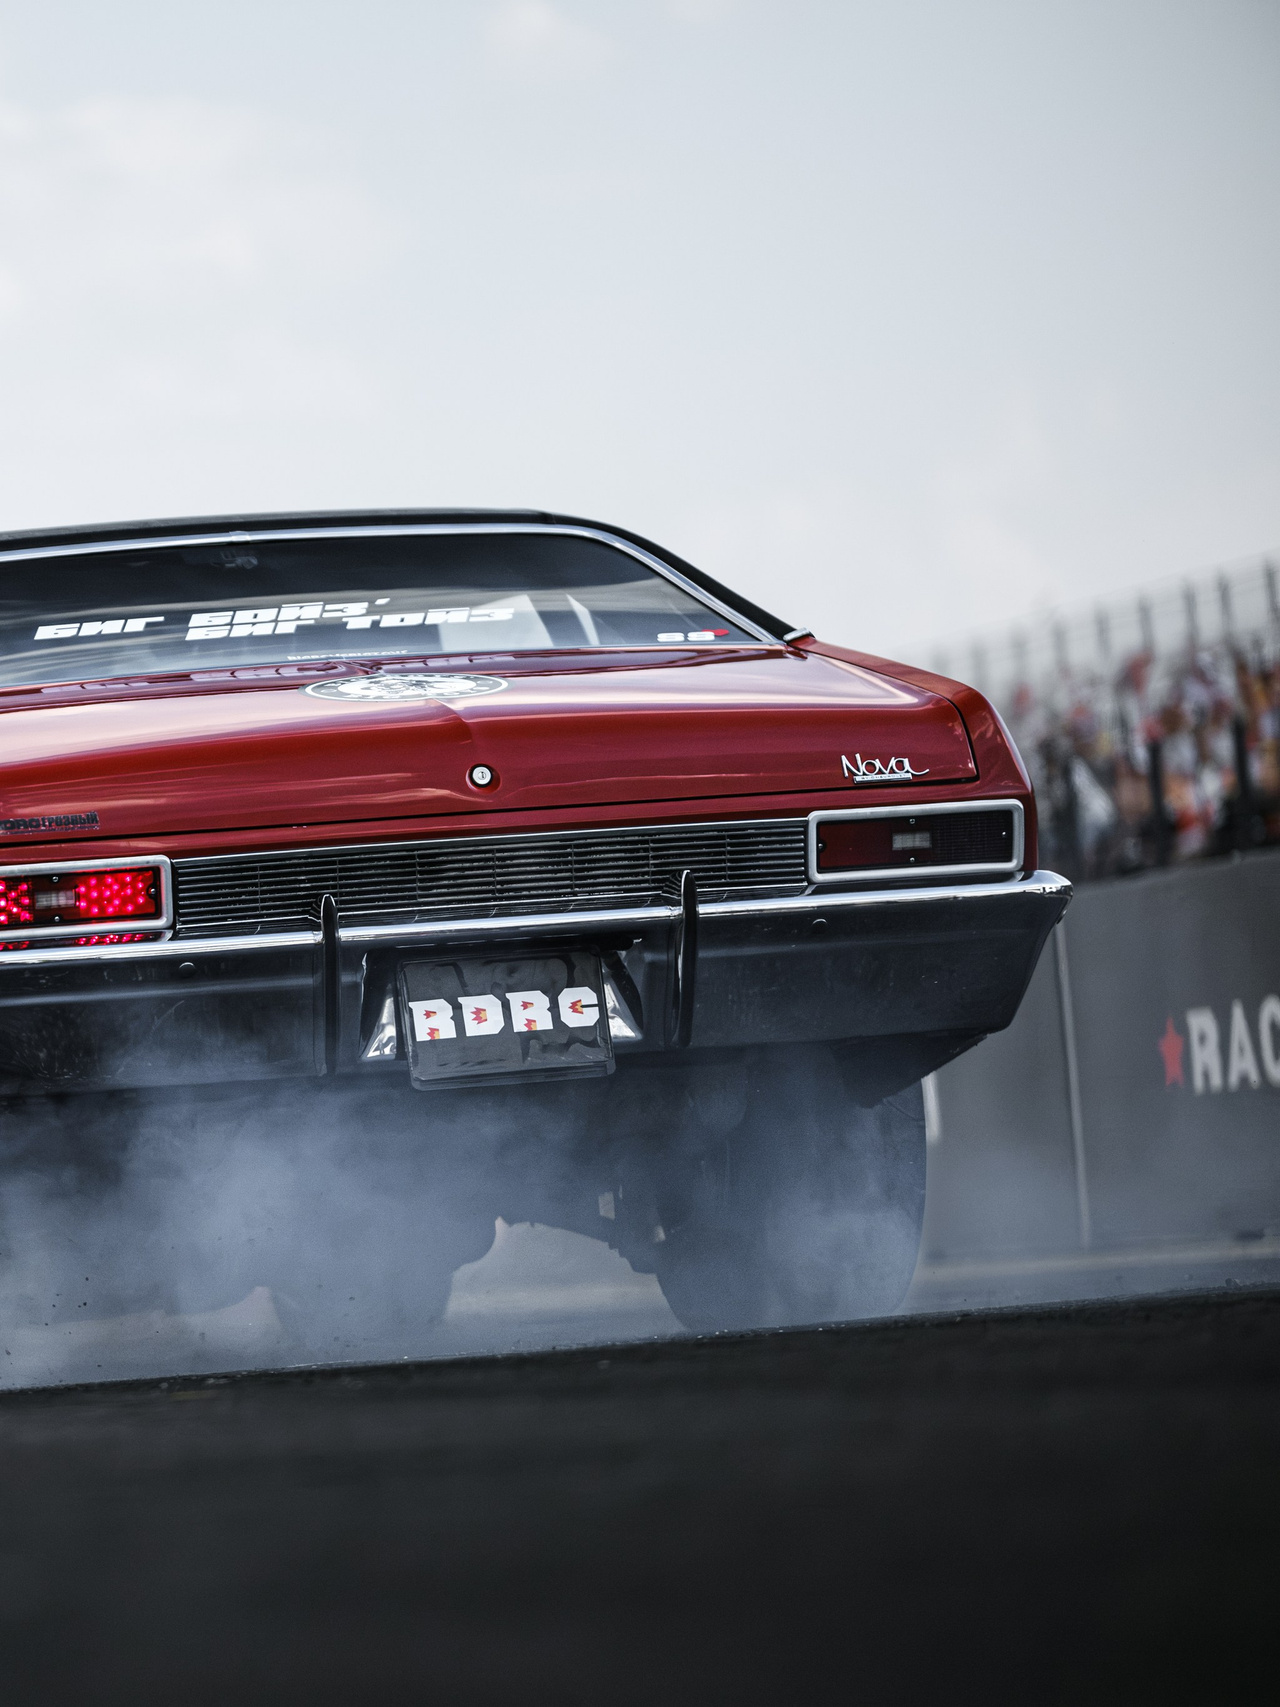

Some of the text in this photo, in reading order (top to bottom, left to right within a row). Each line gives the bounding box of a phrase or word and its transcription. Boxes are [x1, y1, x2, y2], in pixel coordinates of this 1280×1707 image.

[34, 616, 165, 640] БИГ
[185, 607, 515, 641] БИГ ТОЙЗ
[841, 753, 930, 778] Nova
[408, 986, 600, 1042] RDRC
